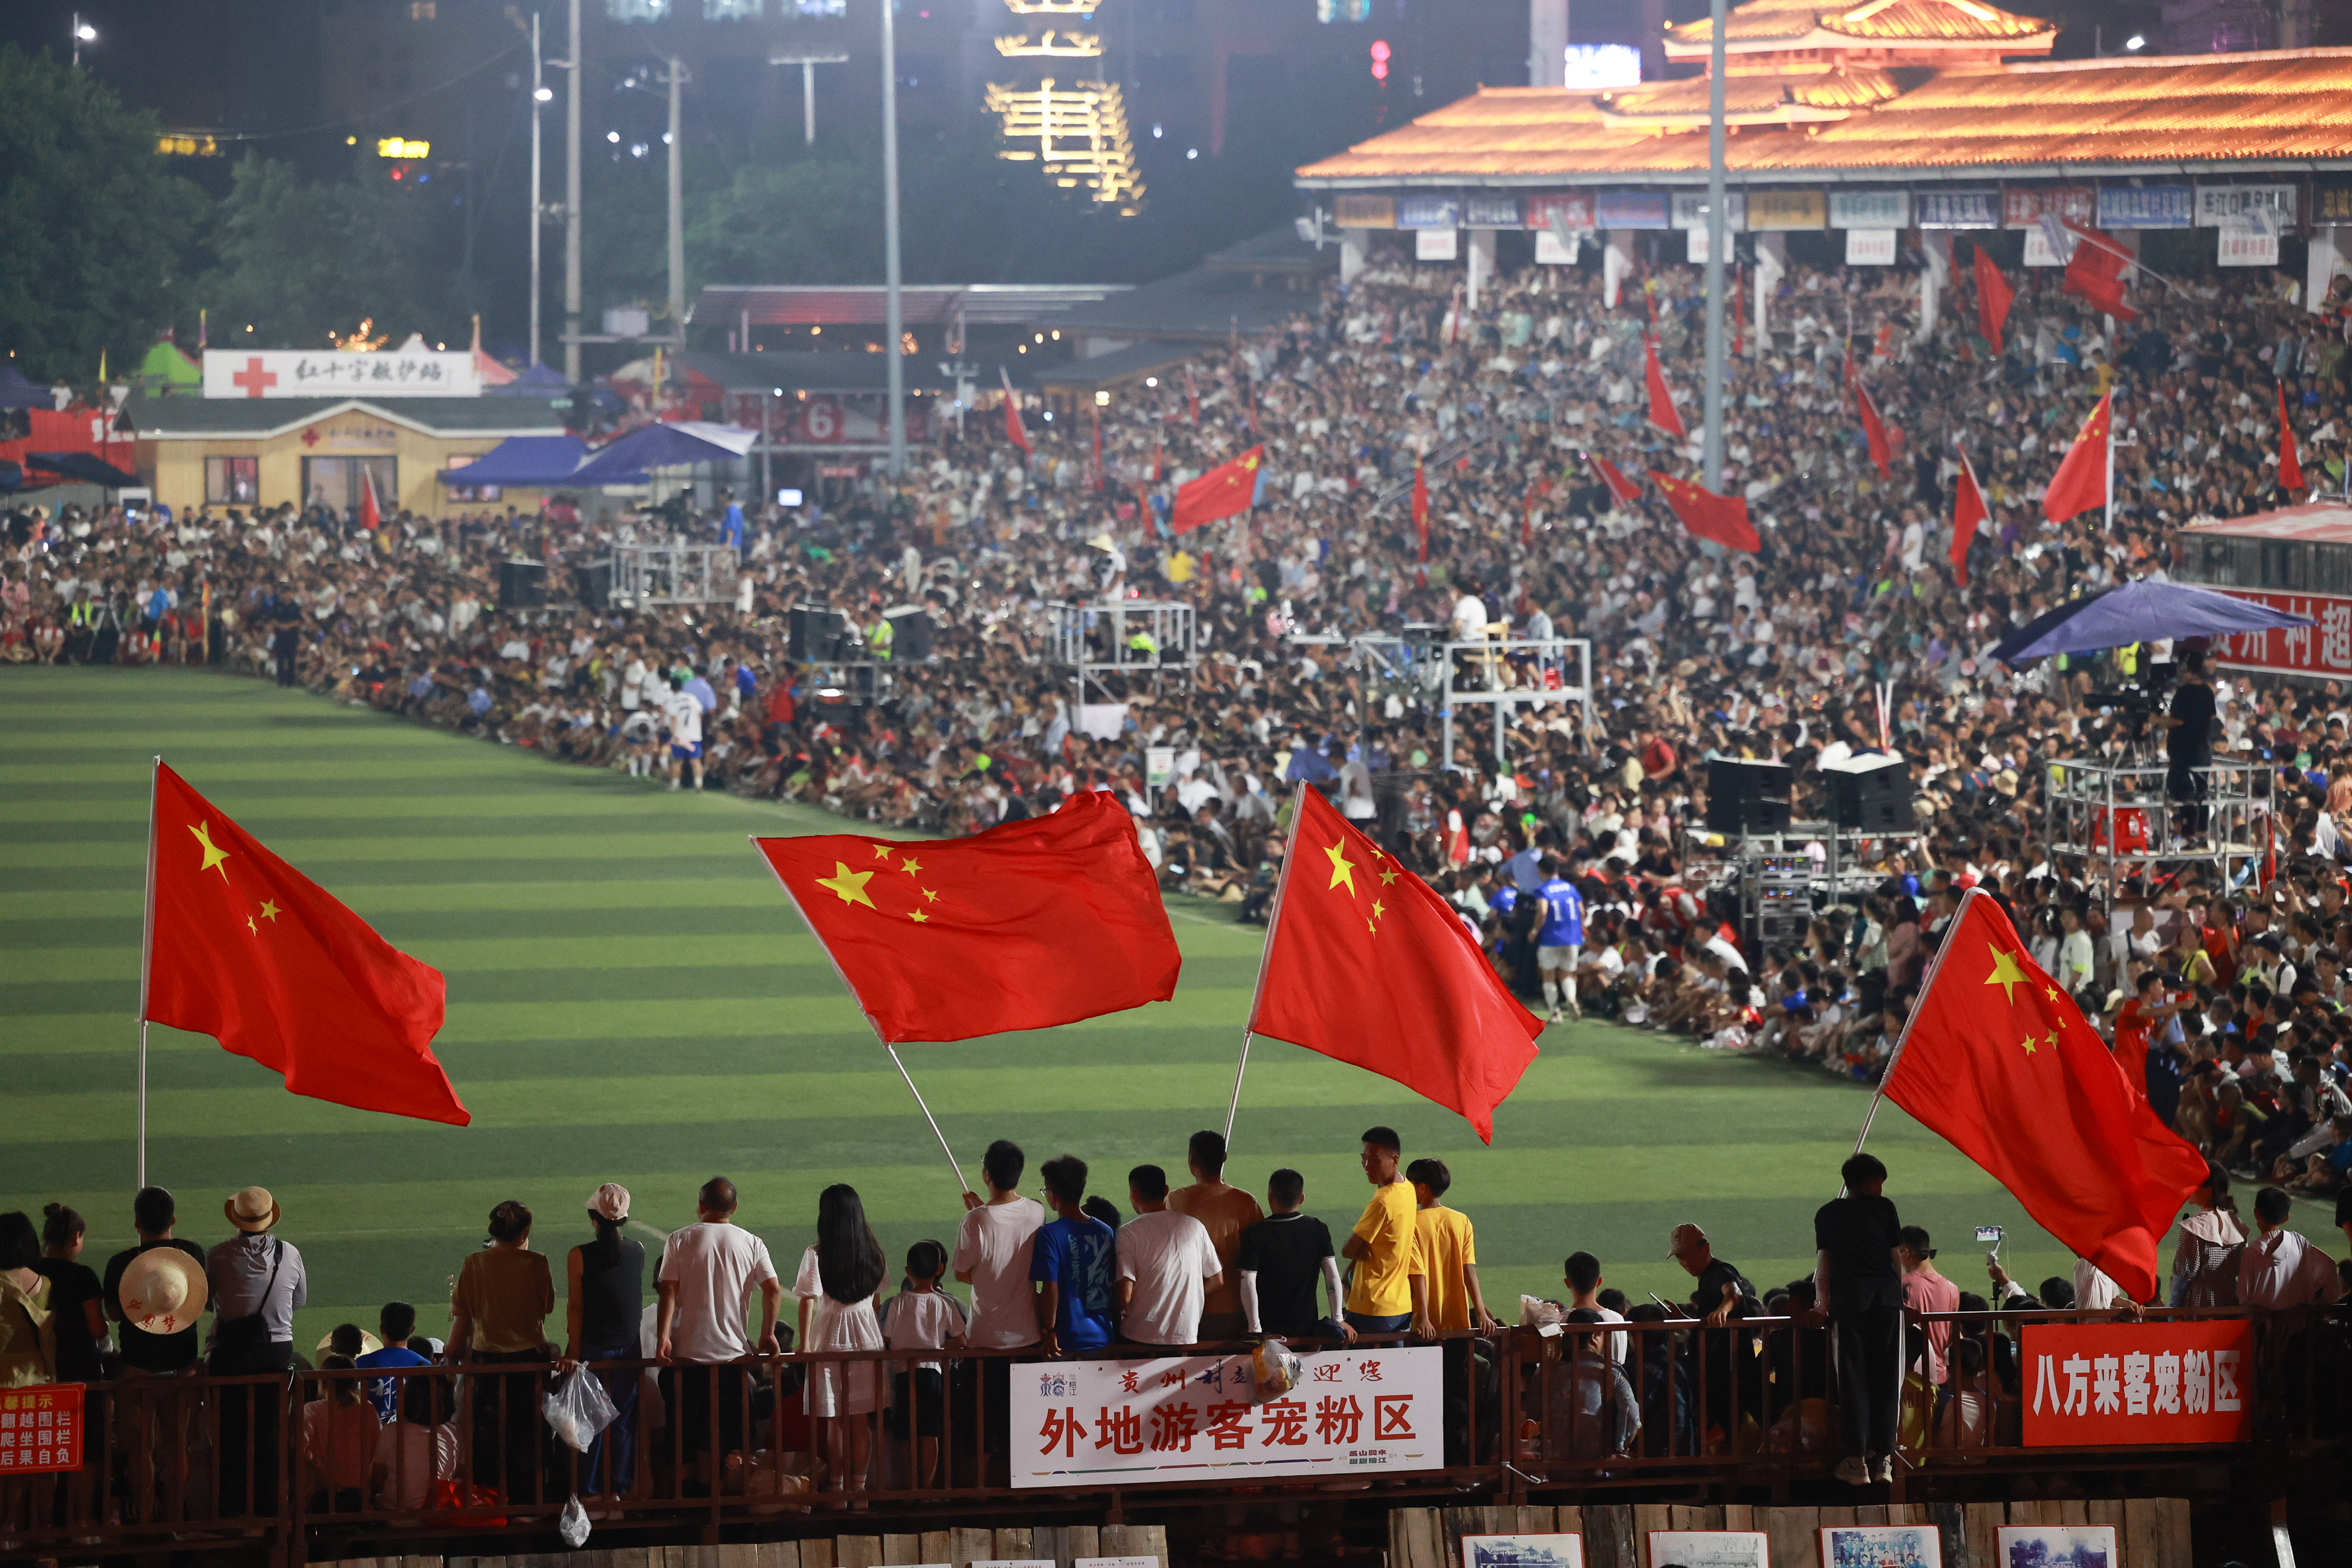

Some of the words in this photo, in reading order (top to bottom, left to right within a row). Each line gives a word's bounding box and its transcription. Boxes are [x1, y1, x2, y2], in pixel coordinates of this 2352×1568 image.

[807, 403, 835, 438] 6
[683, 708, 693, 727] 7
[1551, 896, 1578, 922] 11
[2032, 1349, 2241, 1416] 八方来客宠粉区
[1, 1410, 71, 1429] 翻越围栏
[1039, 1394, 1416, 1458] 外地游客宠粉区
[1, 1429, 71, 1447] 爬坐围栏
[1, 1447, 70, 1466] 后果自负
